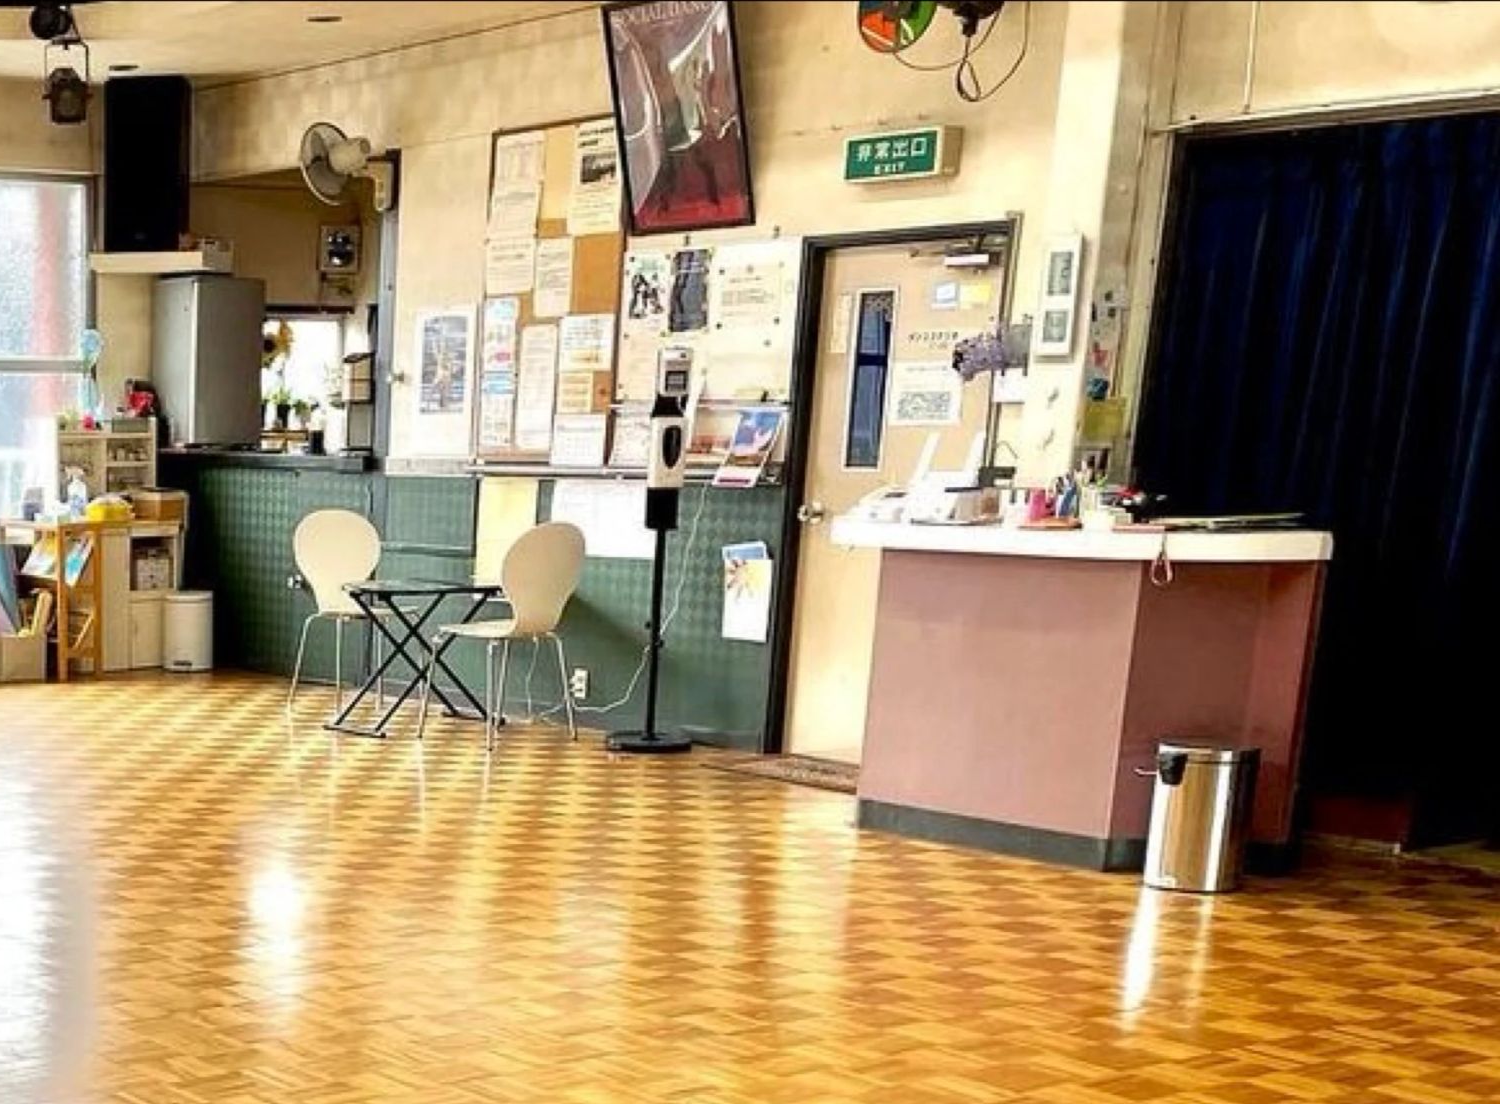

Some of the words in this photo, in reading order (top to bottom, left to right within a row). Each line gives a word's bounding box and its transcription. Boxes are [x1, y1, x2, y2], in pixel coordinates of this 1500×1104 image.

[857, 137, 927, 161] 非常出口
[874, 161, 906, 175] EXIT
